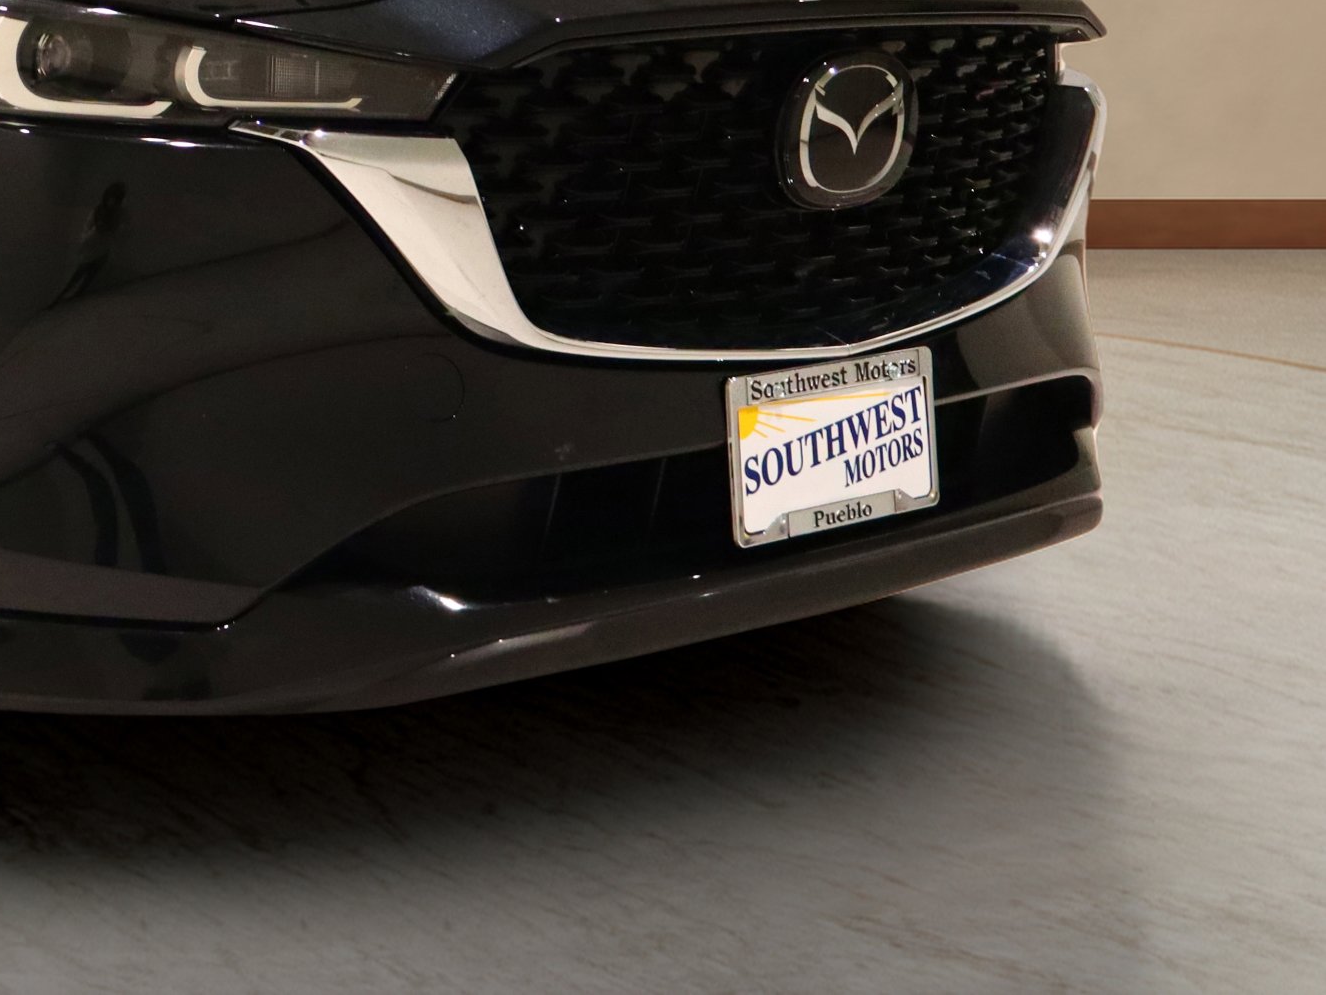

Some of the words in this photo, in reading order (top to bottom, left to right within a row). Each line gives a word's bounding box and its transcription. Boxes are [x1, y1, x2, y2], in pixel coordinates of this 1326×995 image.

[855, 359, 916, 383] Motrs
[745, 386, 921, 495] SOUTHWEST
[844, 428, 924, 487] MOTORS
[814, 502, 872, 528] Pueblo
